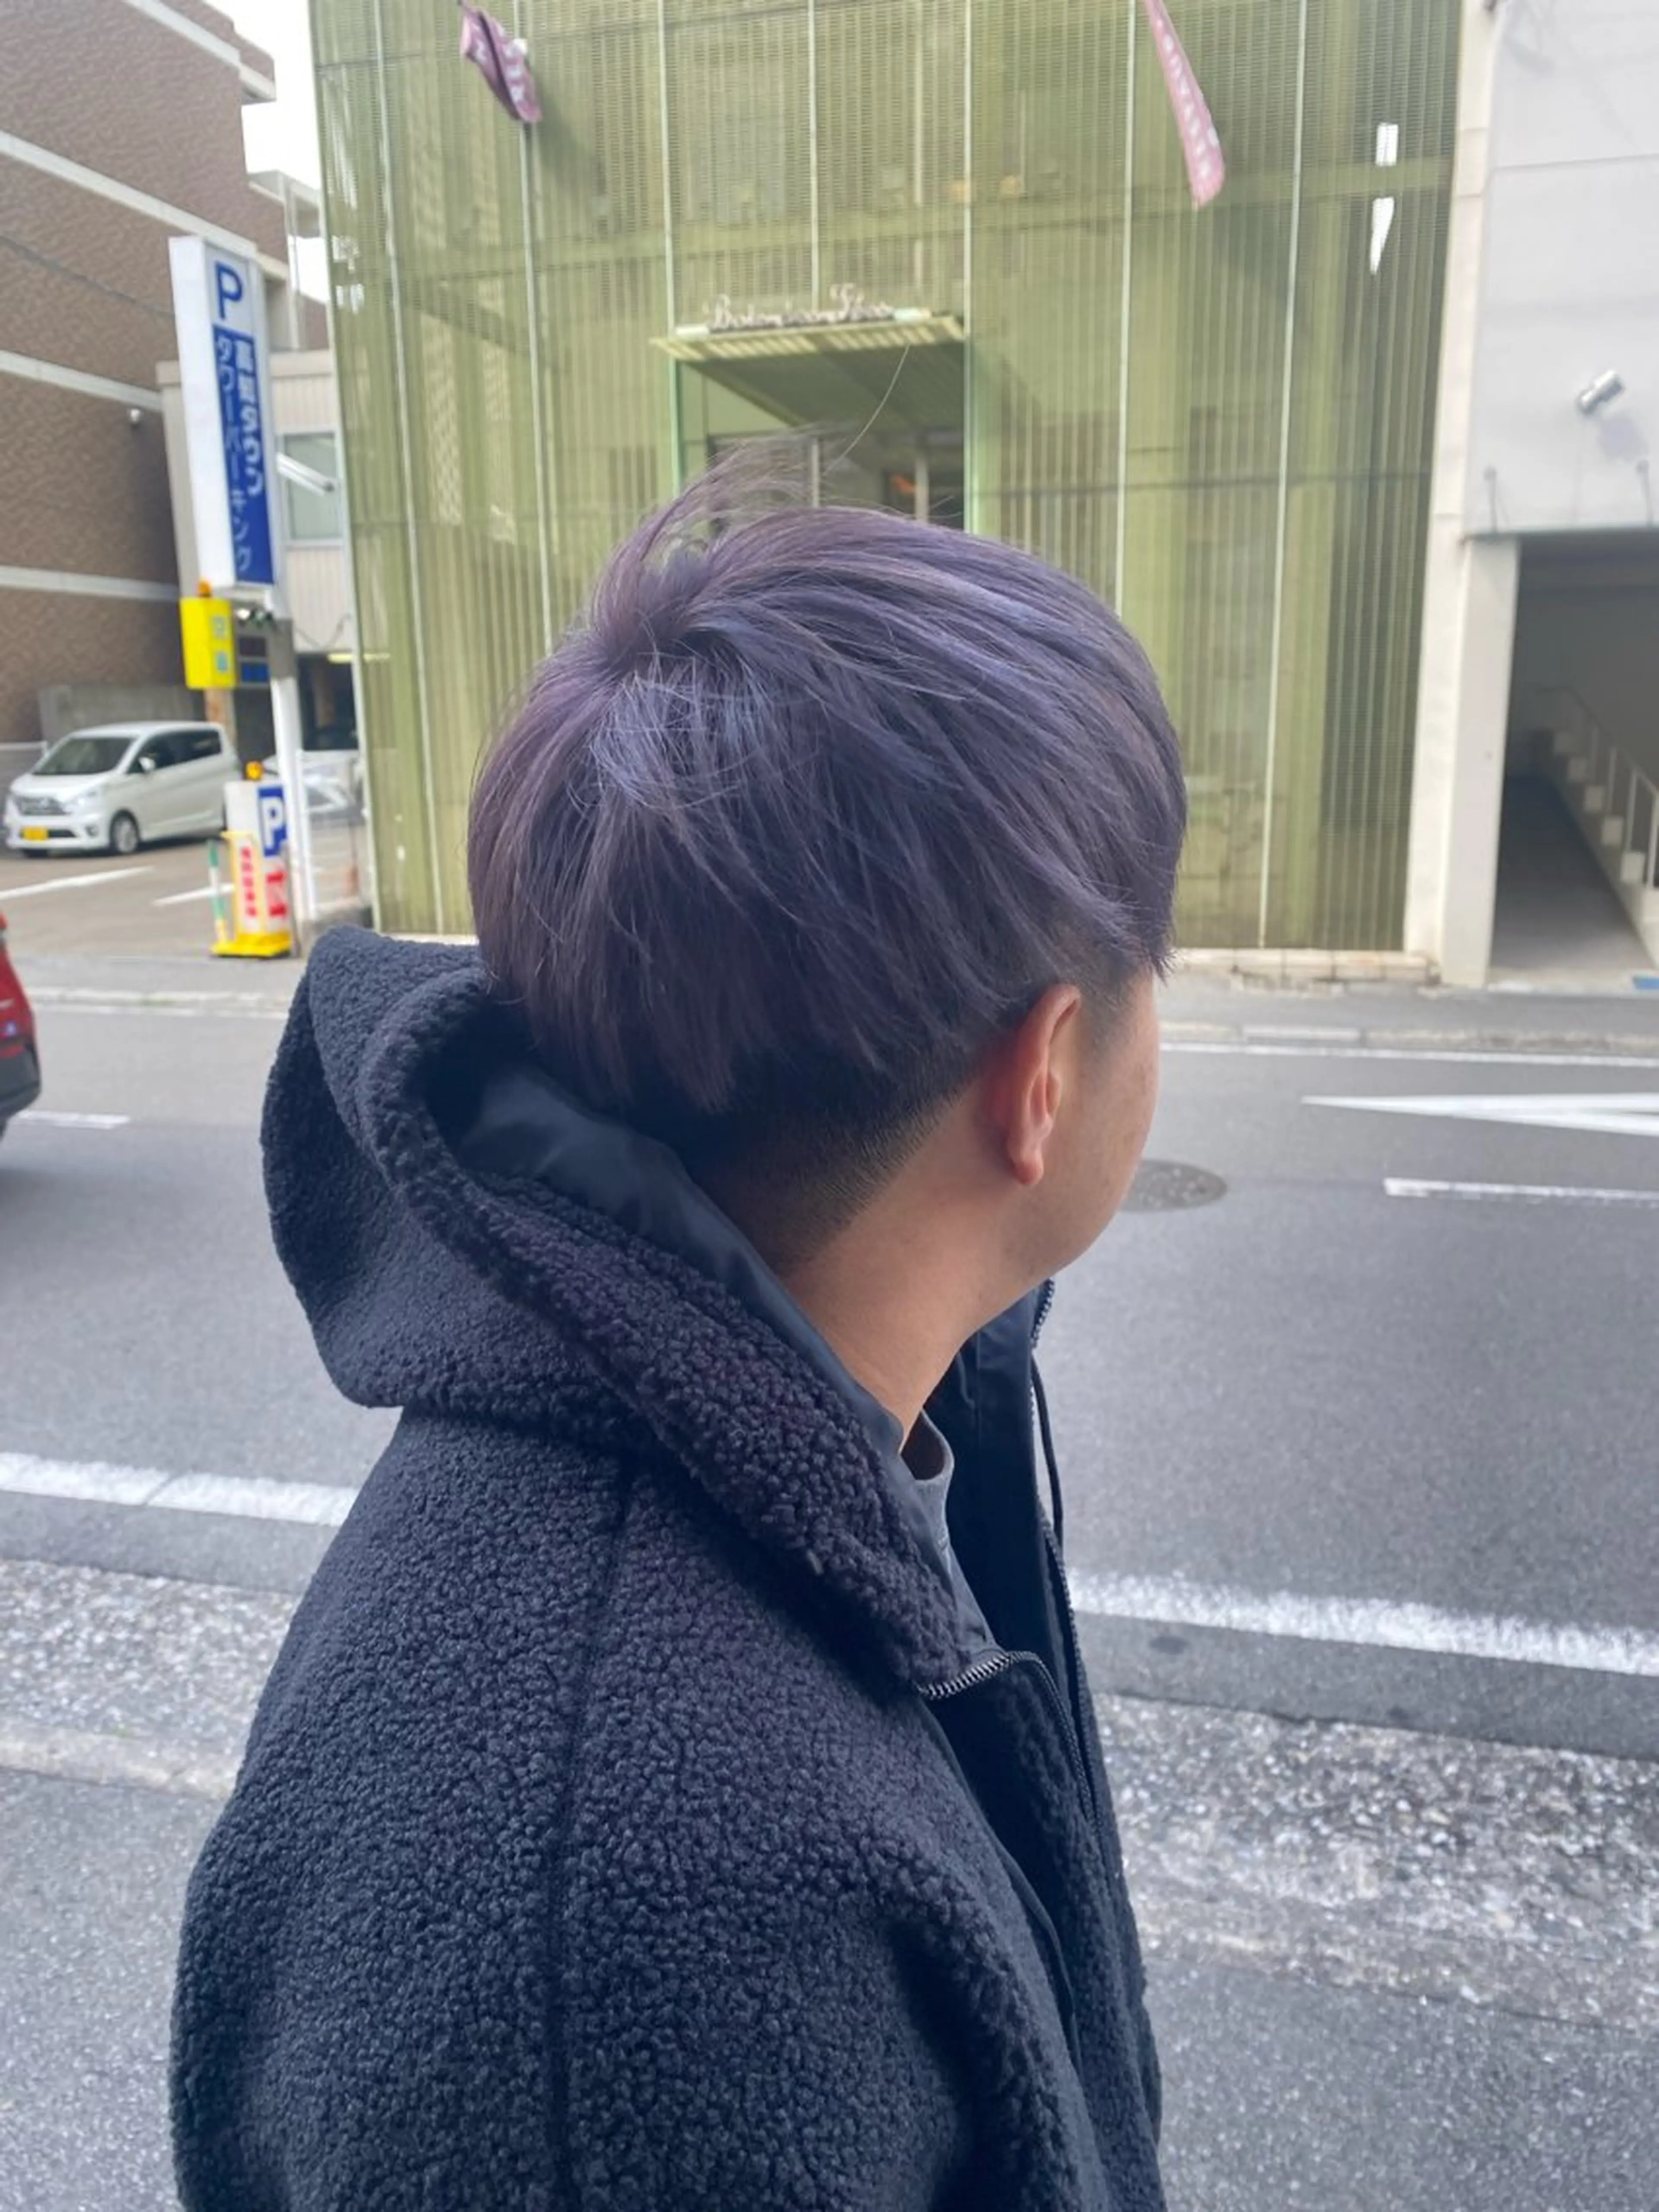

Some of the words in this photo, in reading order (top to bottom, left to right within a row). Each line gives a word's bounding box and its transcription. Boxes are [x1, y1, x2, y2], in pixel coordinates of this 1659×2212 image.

[215, 262, 243, 319] P
[235, 340, 263, 496] タウン
[261, 796, 285, 850] P
